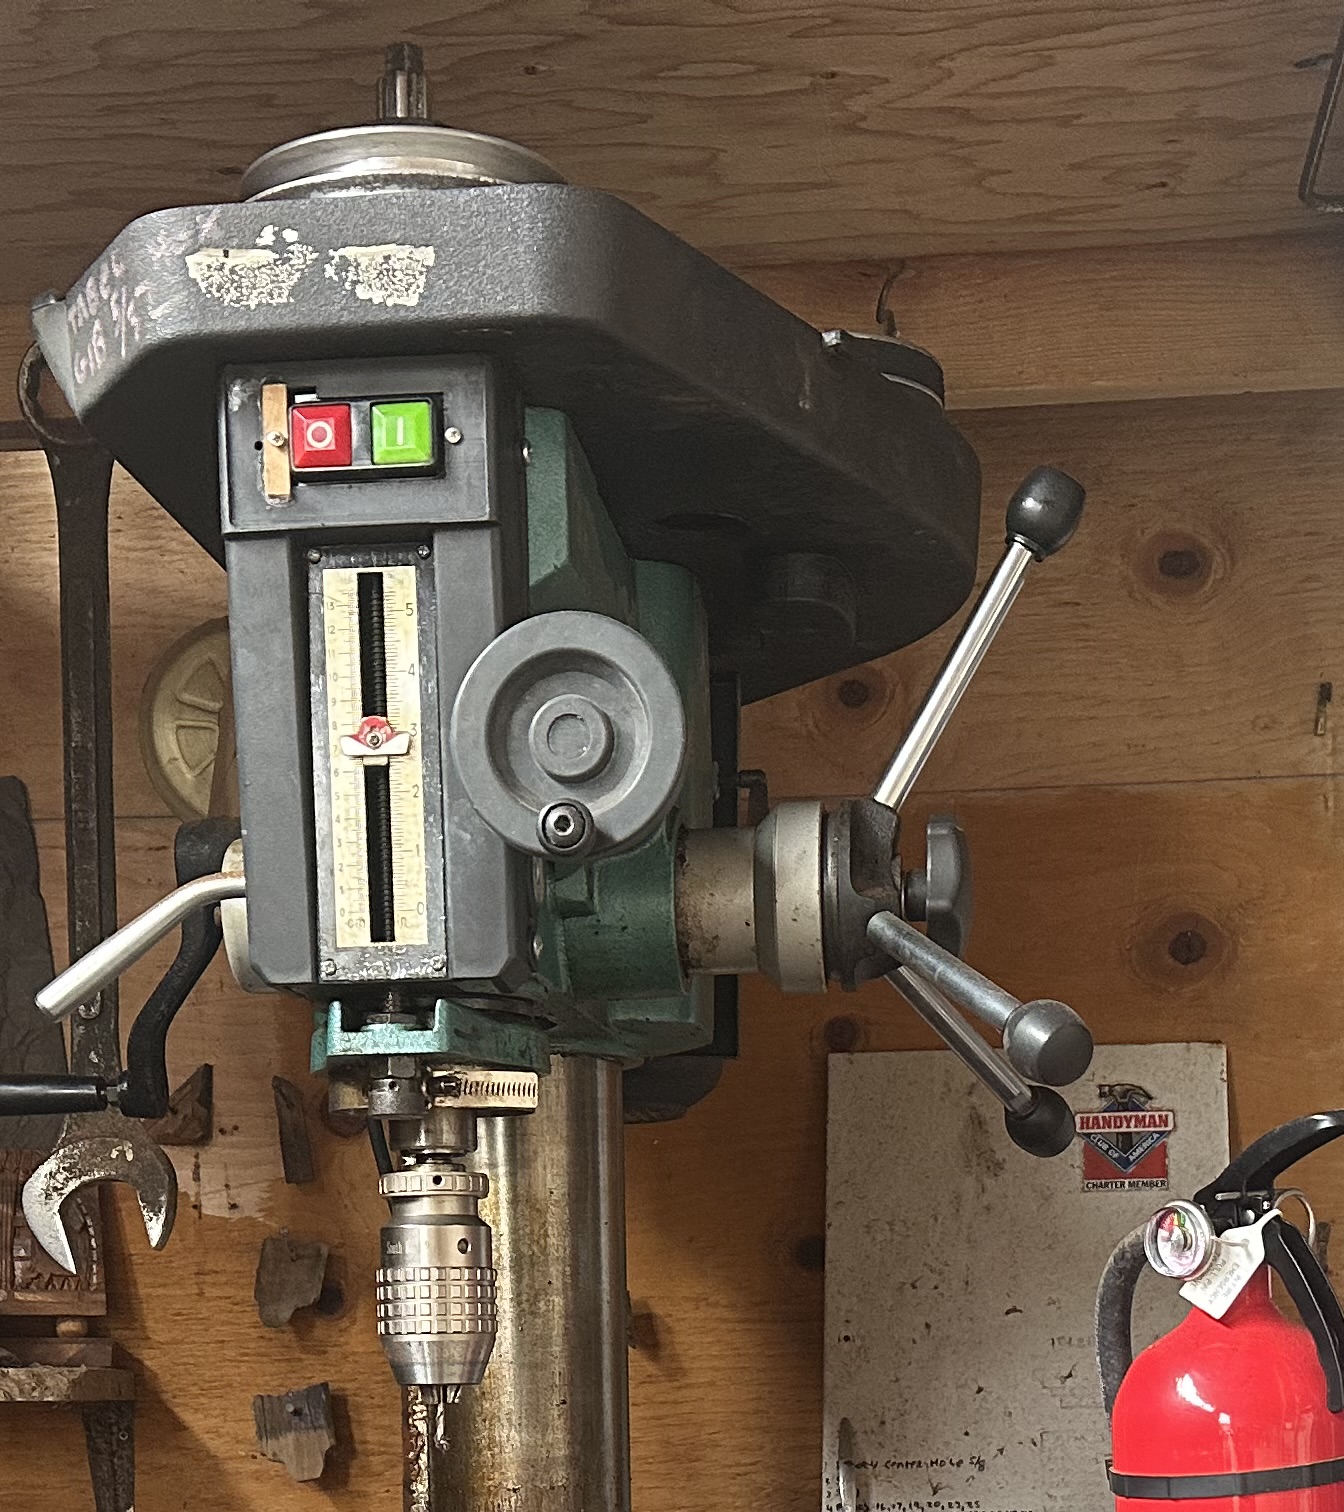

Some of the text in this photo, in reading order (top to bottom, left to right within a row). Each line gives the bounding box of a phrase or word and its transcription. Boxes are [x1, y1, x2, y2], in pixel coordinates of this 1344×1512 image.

[405, 602, 414, 617] 5
[407, 662, 416, 677] 4
[410, 723, 418, 738] 3
[412, 784, 420, 799] 2
[415, 844, 420, 857] 1
[416, 901, 425, 916] 0
[1079, 1113, 1170, 1131] HANDYMAN
[1089, 1132, 1109, 1152] CLUB
[1127, 1131, 1161, 1163] AMERICA
[1085, 1179, 1169, 1190] CHARTER MEMBER
